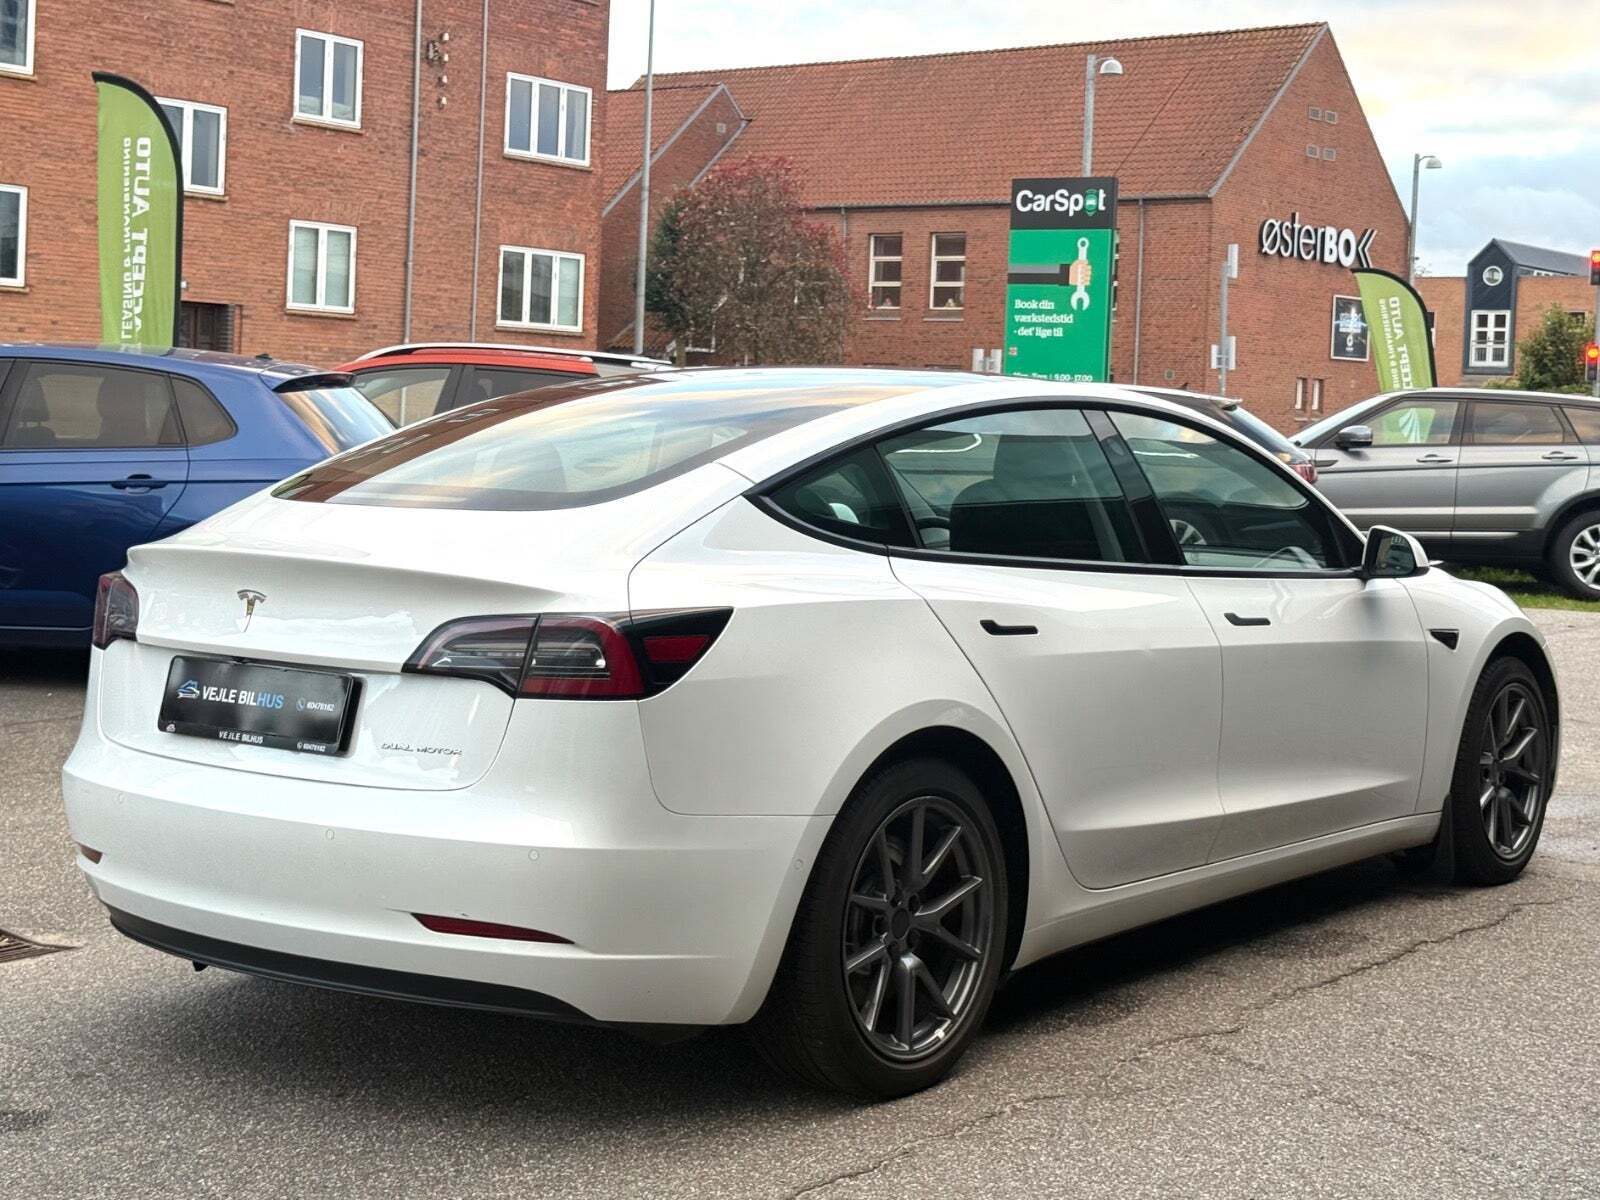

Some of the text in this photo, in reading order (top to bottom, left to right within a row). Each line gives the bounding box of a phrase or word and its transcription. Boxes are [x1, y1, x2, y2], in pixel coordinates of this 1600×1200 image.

[1015, 188, 1106, 217] CarSpot
[1014, 299, 1055, 310] Book din
[1014, 313, 1074, 324] værkstedstid
[1035, 327, 1053, 339] lige
[1053, 327, 1063, 337] til
[202, 685, 284, 709] VEJLE BILHUS
[218, 730, 264, 744] VEJLE BILHUS
[381, 742, 463, 755] DUAL MOTOR
